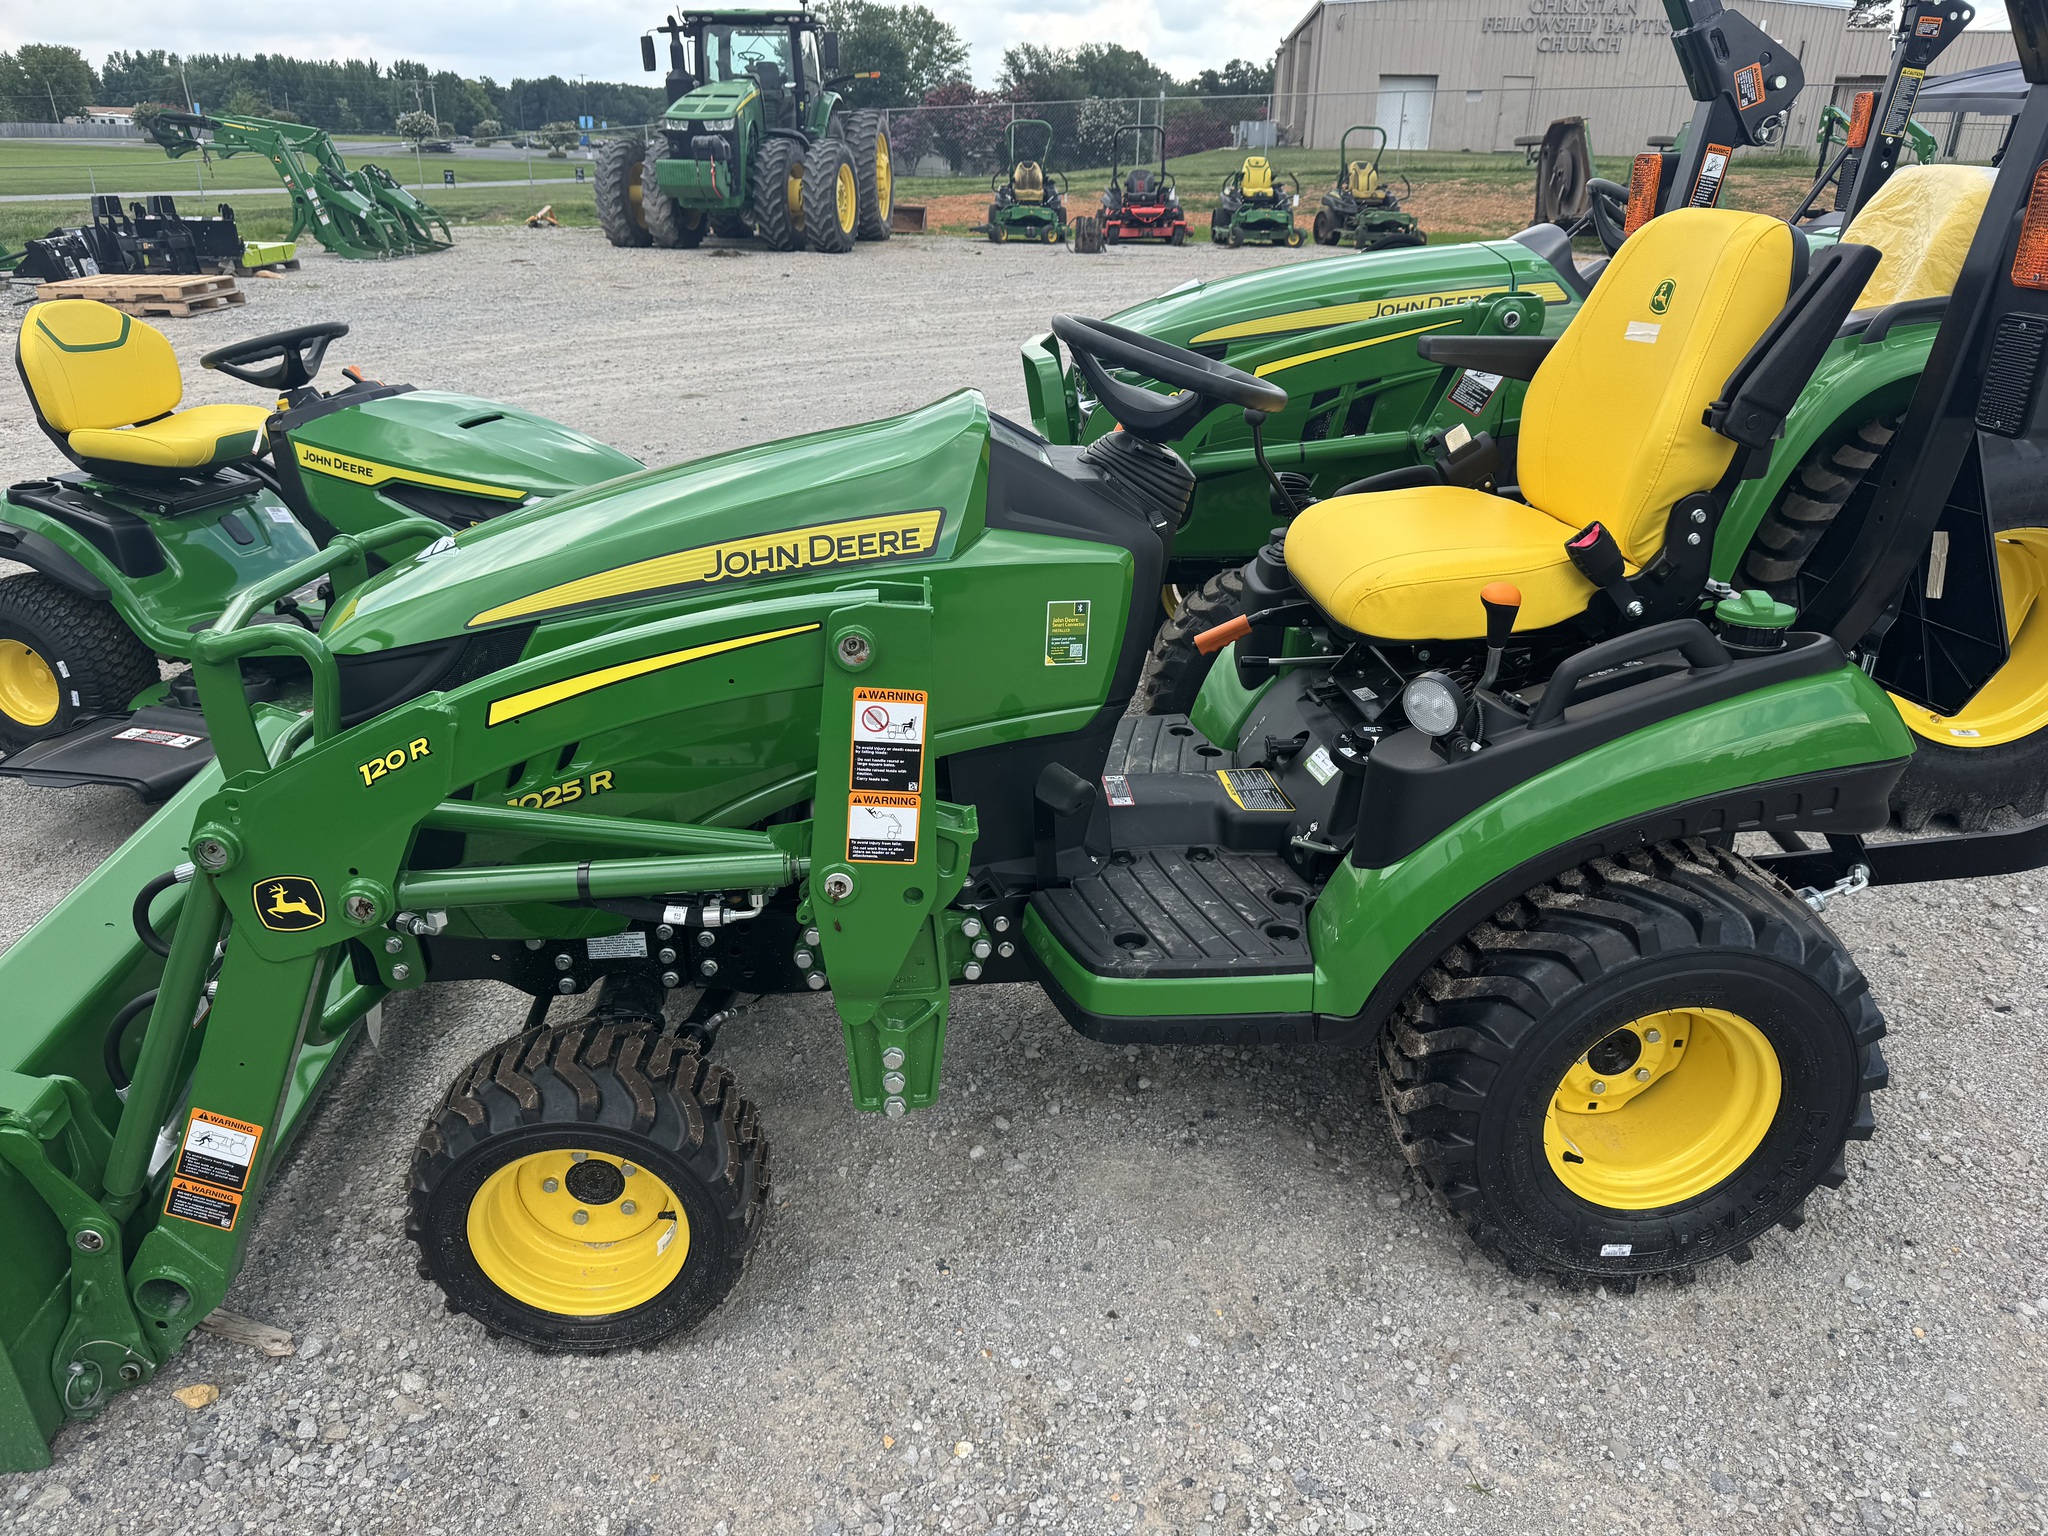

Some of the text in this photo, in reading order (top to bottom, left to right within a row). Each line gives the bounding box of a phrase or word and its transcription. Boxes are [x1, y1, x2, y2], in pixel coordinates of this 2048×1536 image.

[1529, 0, 1638, 15] CHRISTIAN
[1482, 16, 1671, 35] FELLOWSHIP BAPTIS
[1537, 36, 1622, 53] CHURCH
[1369, 301, 1424, 319] JOHN
[303, 449, 373, 478] JOHN DEERE
[703, 527, 922, 579] JOHN DEERE
[868, 690, 924, 702] WARNING
[358, 737, 432, 788] 120 R
[589, 769, 615, 795] R
[864, 796, 916, 806] WARNING
[210, 1116, 254, 1132] WARNING
[192, 1185, 234, 1202] WARNING
